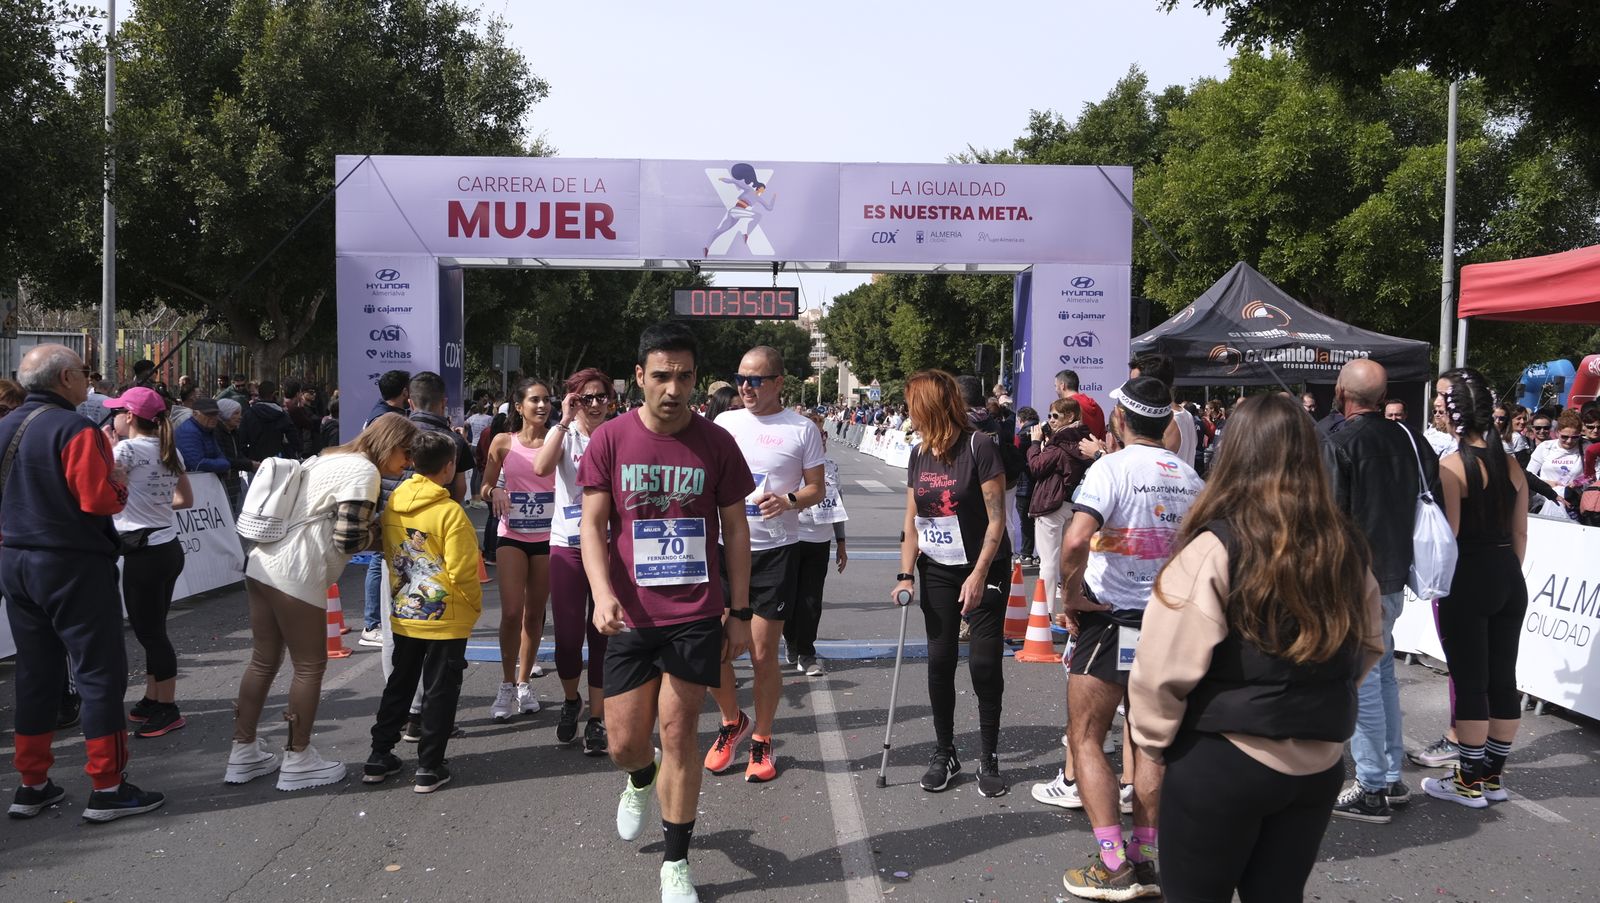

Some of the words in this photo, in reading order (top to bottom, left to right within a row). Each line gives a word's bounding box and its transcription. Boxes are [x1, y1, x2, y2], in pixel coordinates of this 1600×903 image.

[457, 176, 547, 193] CARRERA
[552, 177, 577, 193] DE
[583, 178, 606, 194] LA
[891, 181, 912, 196] LA
[917, 181, 1006, 197] IGUALDAD
[863, 205, 886, 219] ES
[890, 205, 975, 221] NUESTRA
[978, 206, 1033, 221] META.
[448, 200, 616, 240] MUJER
[871, 231, 897, 244] CDX
[377, 305, 413, 314] cajamar
[1071, 312, 1106, 320] cajamar
[369, 329, 400, 341] CASI
[1063, 335, 1093, 347] CASI
[380, 350, 412, 359] vithas
[445, 342, 461, 368] CDX
[1073, 356, 1104, 365] vithas
[1079, 382, 1103, 391] ualia
[621, 464, 705, 495] MESTIZO
[519, 504, 544, 515] 473
[817, 499, 838, 509] 1324
[923, 529, 953, 544] 1325
[658, 537, 685, 556] 70
[1526, 611, 1591, 647] CIUDAD
